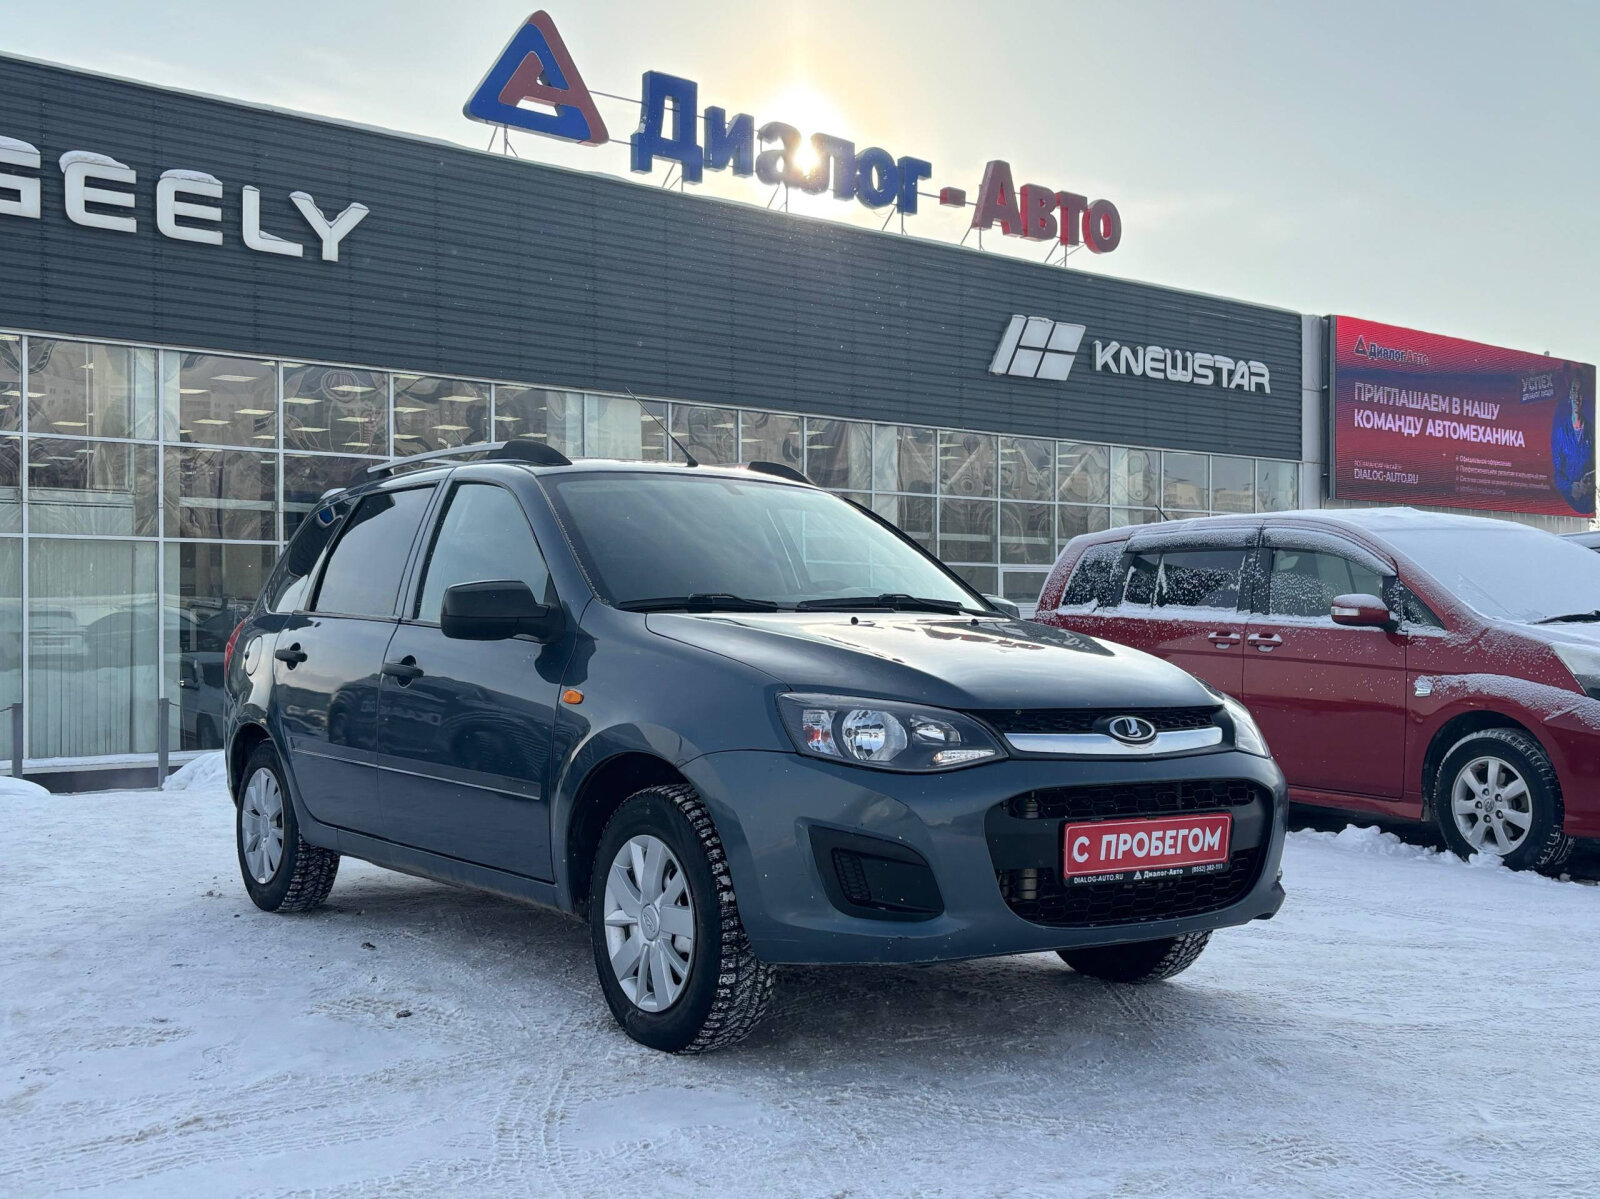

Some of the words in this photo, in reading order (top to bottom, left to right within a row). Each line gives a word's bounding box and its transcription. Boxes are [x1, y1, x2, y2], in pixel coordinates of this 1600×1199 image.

[1092, 340, 1271, 394] KNEWSTAR
[1354, 382, 1450, 414] ПРИГЛАШАЕМ
[1451, 397, 1461, 415] В
[1463, 399, 1500, 420] НАШУ
[1354, 408, 1423, 437] КОМАНДУ
[1426, 418, 1526, 448] АВТОМЕХАНИКА
[1072, 836, 1090, 863] С
[1100, 825, 1222, 861] ПРОБЕГОМ
[1073, 873, 1124, 884] DIALOG-AUTO.RU
[1143, 868, 1183, 879] Диалог-Авто
